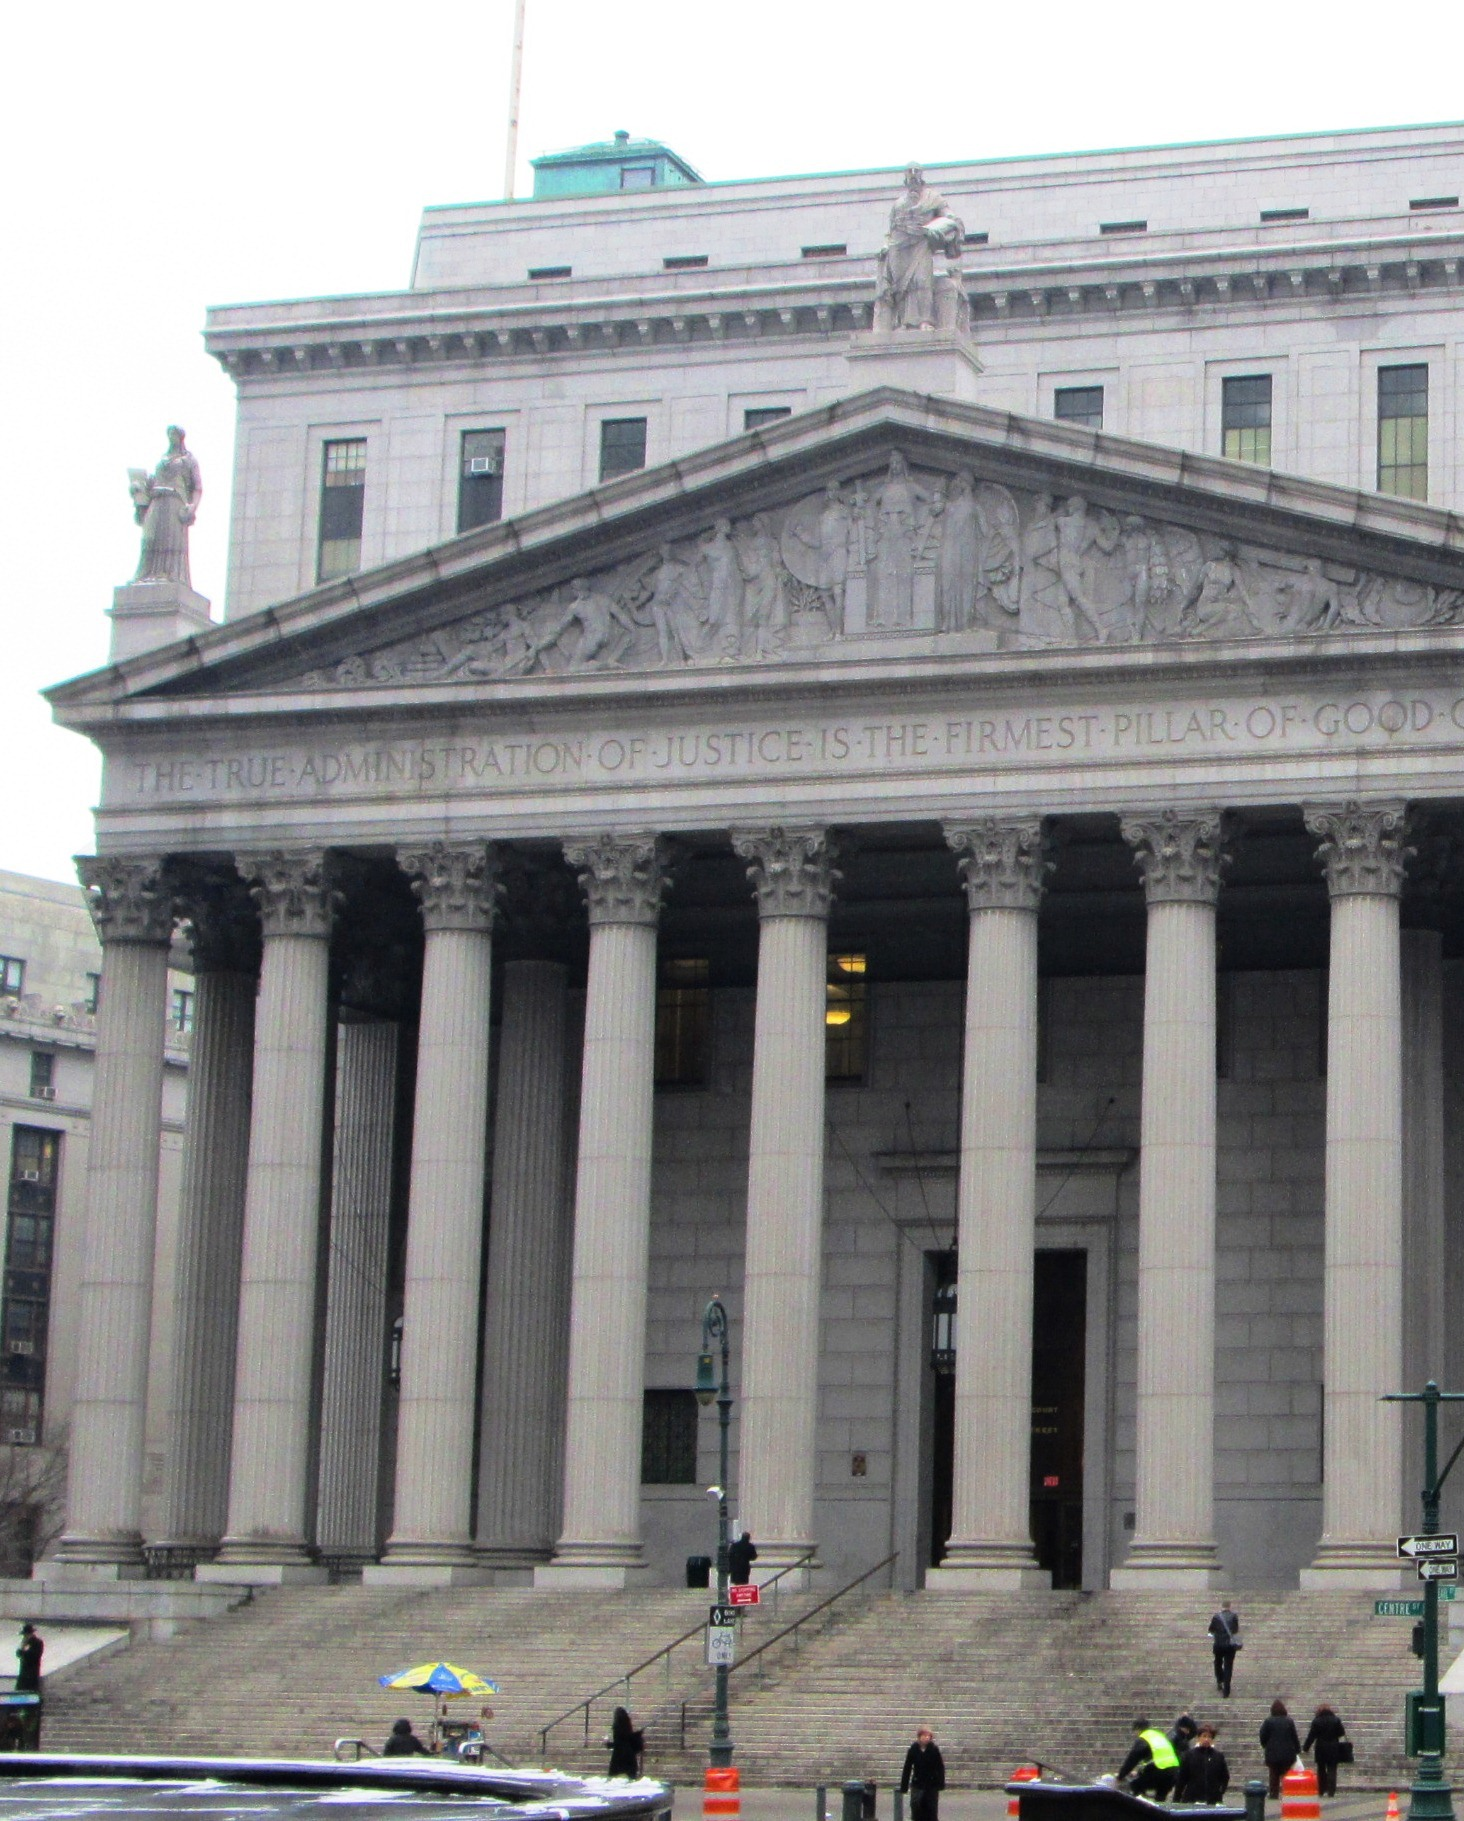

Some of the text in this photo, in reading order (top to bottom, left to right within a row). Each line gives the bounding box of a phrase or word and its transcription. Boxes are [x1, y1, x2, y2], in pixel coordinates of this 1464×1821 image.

[134, 760, 195, 793] THE
[203, 756, 289, 790] TRUE
[298, 739, 585, 786] ADMINISTRATION
[600, 738, 646, 771] OF
[655, 728, 804, 769] JUSTICE
[819, 727, 850, 761] IS
[863, 722, 929, 759] THE
[944, 714, 1098, 754] FIRMEST
[1113, 708, 1236, 747] PILLAR
[1245, 705, 1298, 739] OF
[1313, 699, 1435, 737] GOOD
[1416, 1541, 1451, 1550] ONE WAY
[1378, 1602, 1410, 1615] CENTRE
